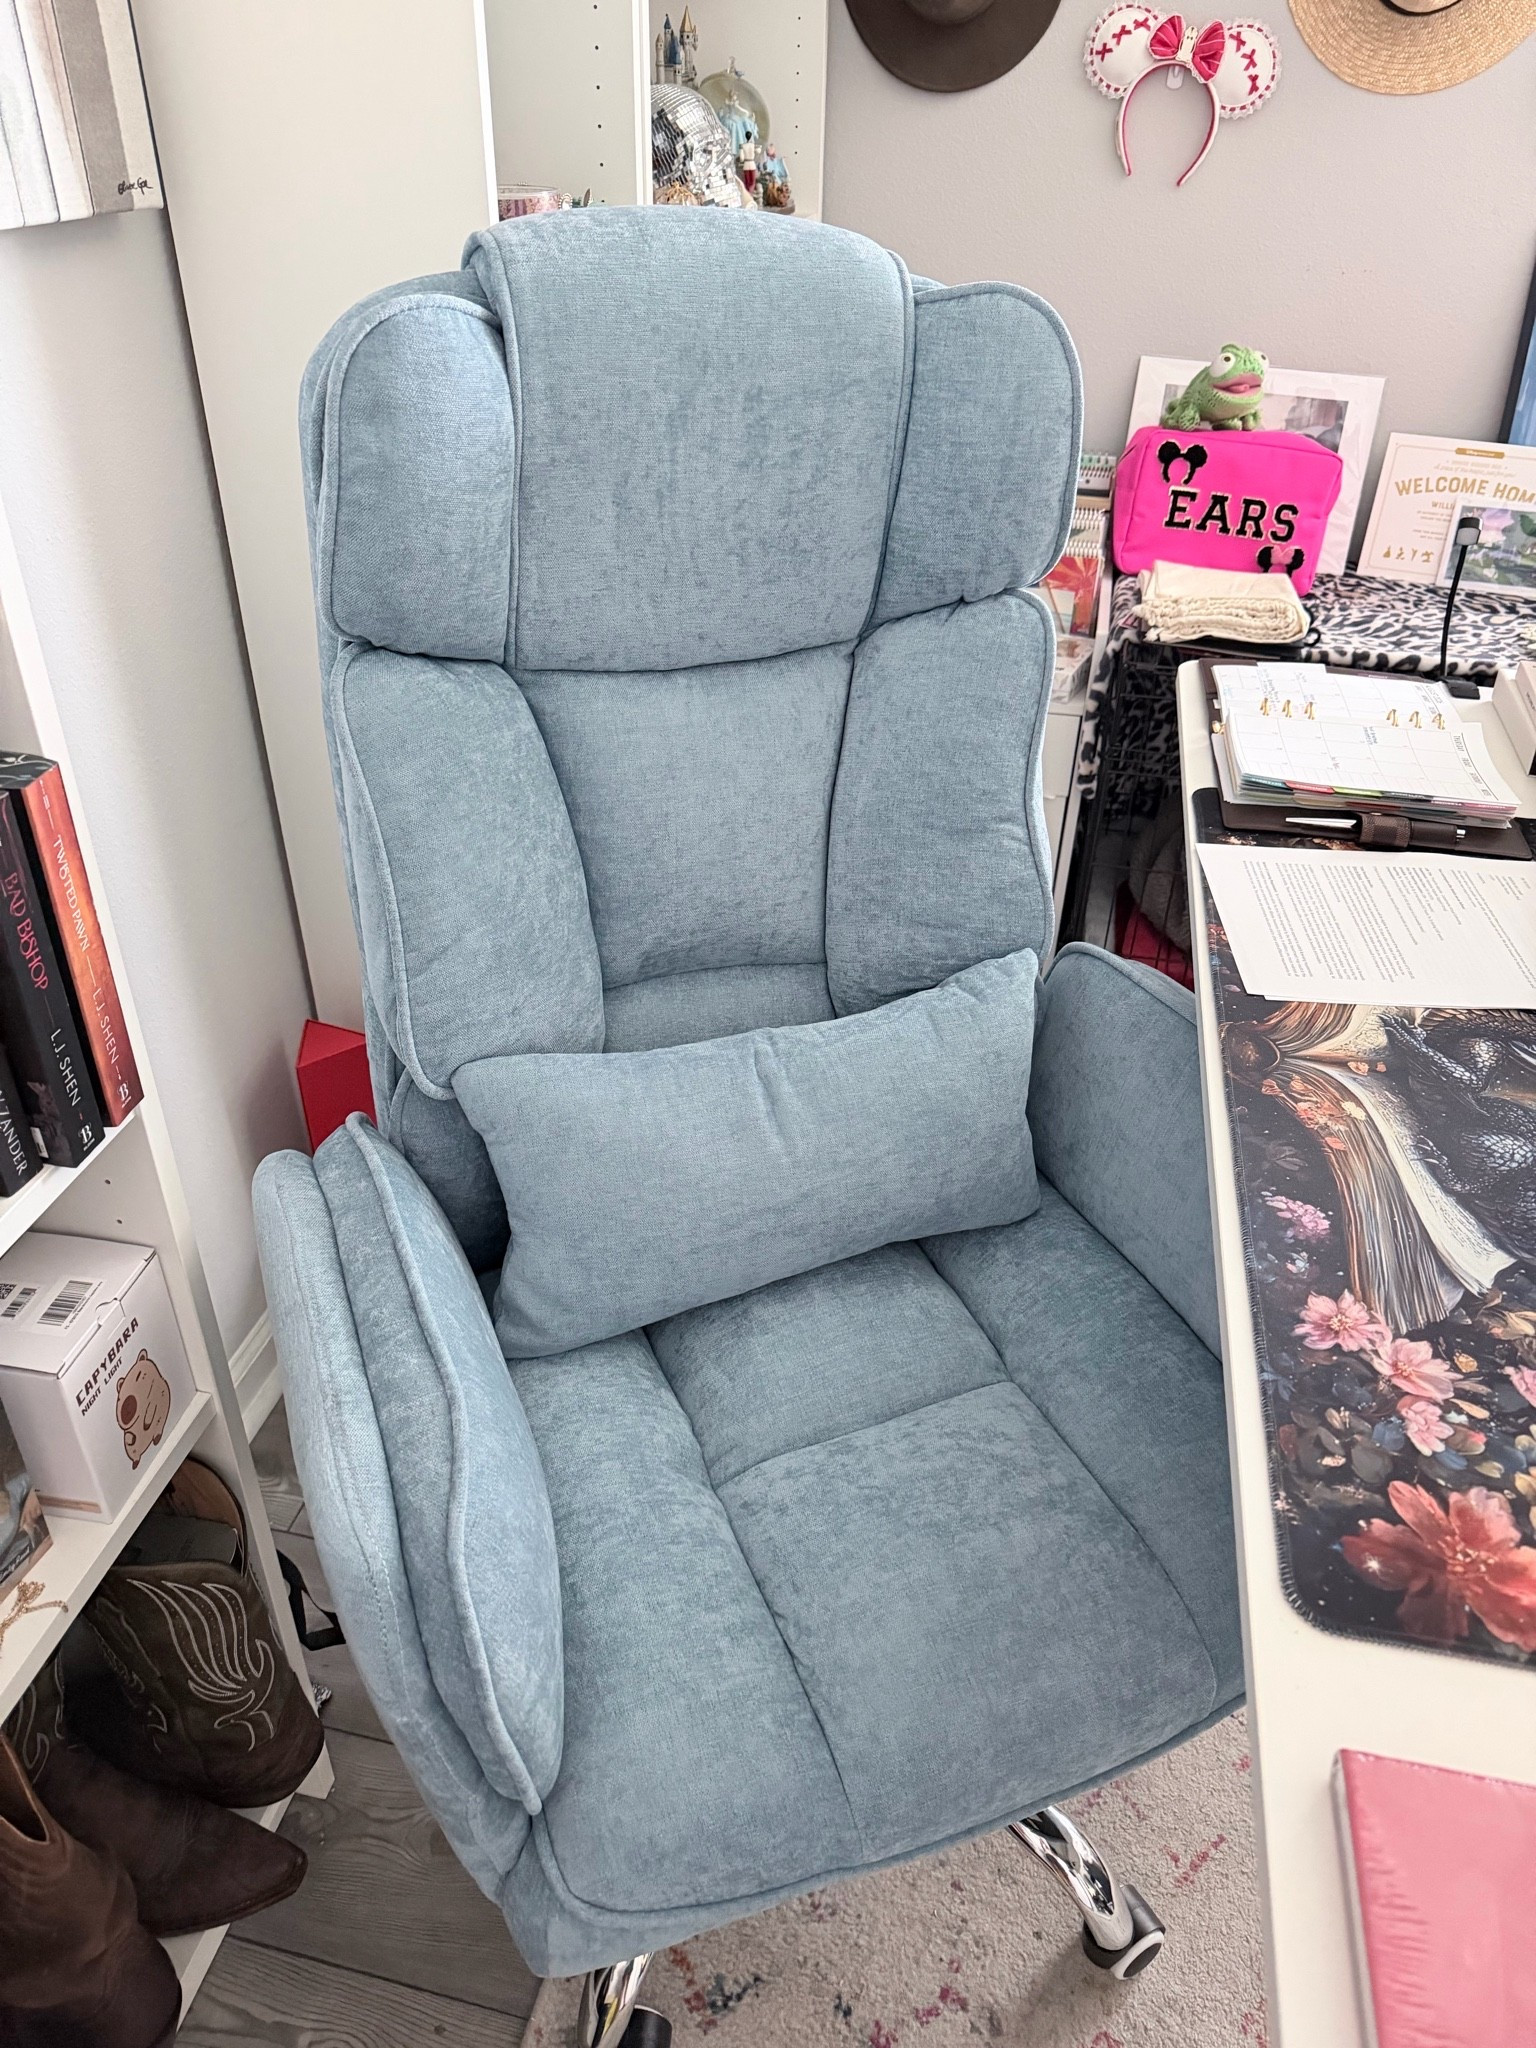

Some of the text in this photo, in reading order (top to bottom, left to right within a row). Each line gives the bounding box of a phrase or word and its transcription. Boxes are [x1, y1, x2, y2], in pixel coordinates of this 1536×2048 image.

[1163, 487, 1299, 543] EARS
[1395, 476, 1489, 496] WELCOME
[53, 834, 90, 952] TWISTED PAWN
[5, 872, 49, 990] BAD BISHOP
[100, 1015, 119, 1065] SHEN
[59, 1056, 81, 1107] SHEN
[75, 1316, 139, 1408] CAPYBARA
[81, 1356, 123, 1417] NIGHT LIGHT
